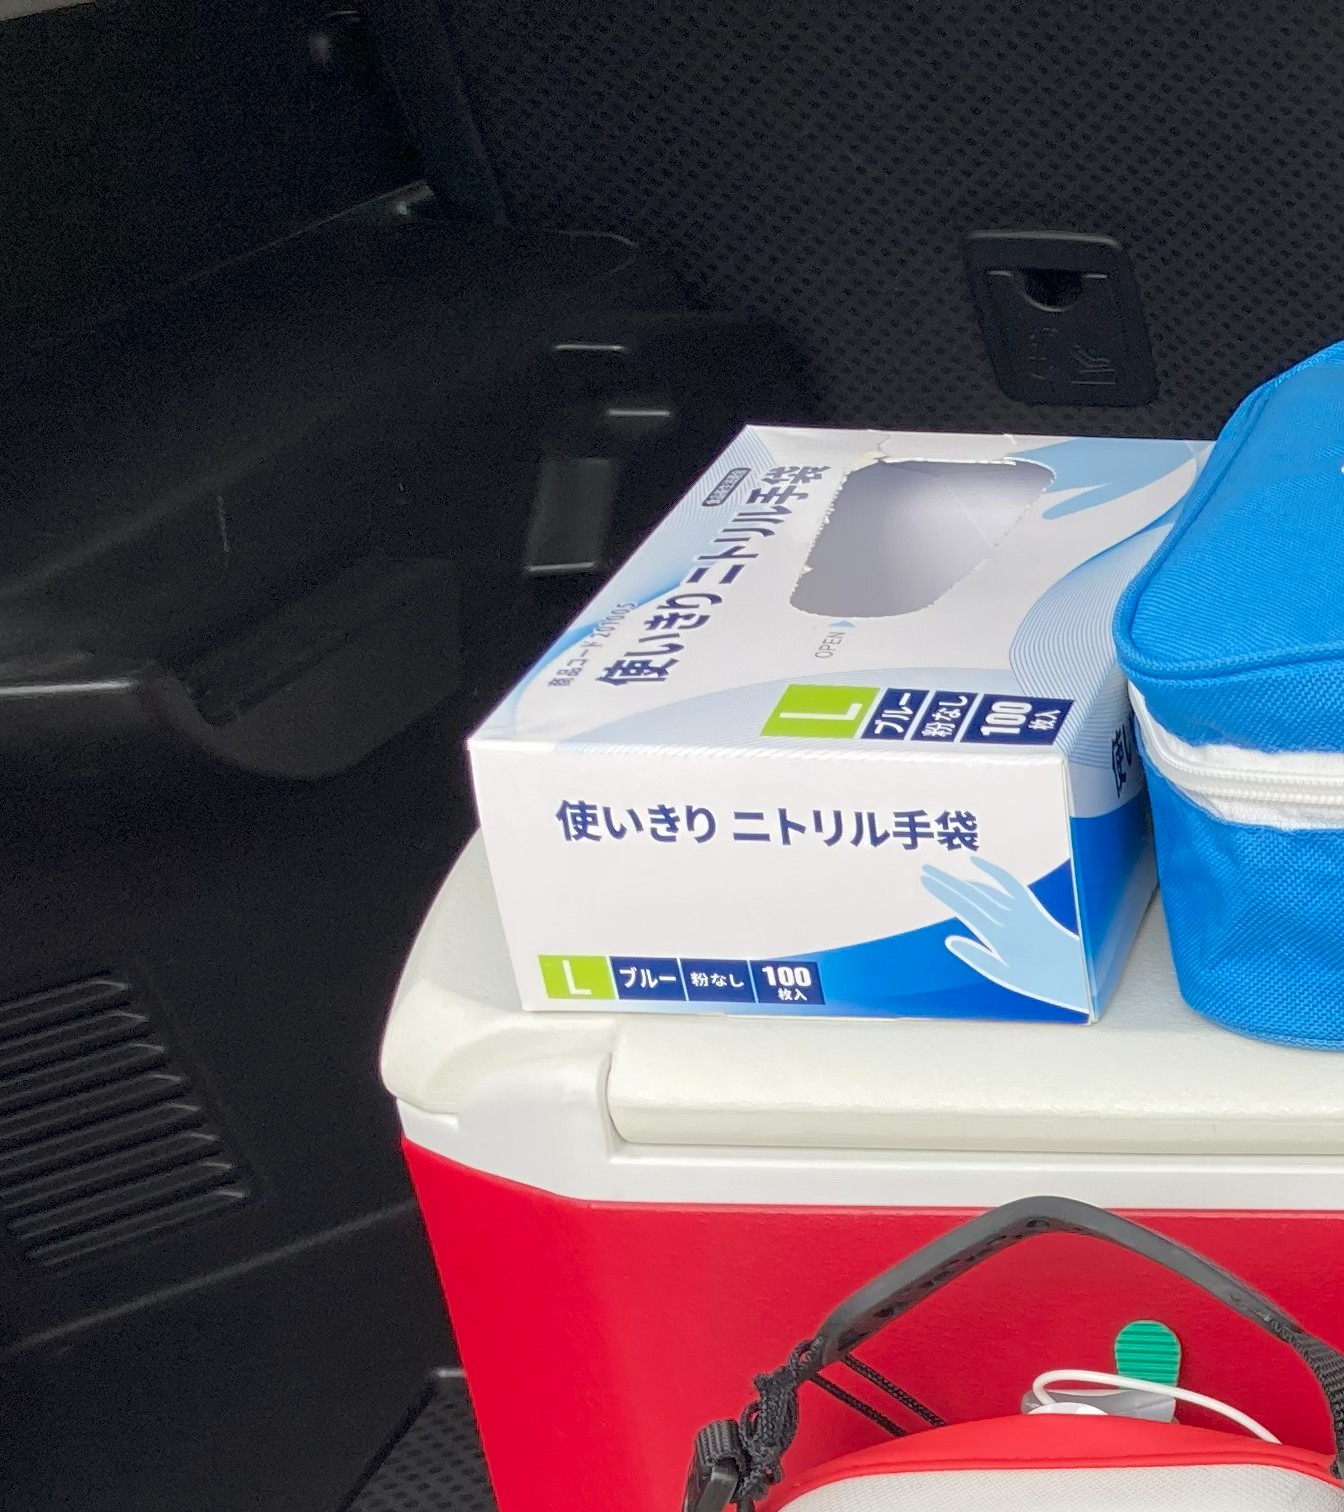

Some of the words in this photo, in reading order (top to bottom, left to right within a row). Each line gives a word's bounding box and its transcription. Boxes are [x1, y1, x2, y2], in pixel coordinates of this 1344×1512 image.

[595, 592, 723, 686] 使いきり
[685, 465, 831, 584] ニトリル手袋
[814, 631, 847, 659] OPEN
[779, 703, 863, 721] L
[874, 692, 911, 735] ブルー
[921, 695, 969, 737] 粉なし
[980, 701, 1032, 736] 100
[1028, 709, 1062, 731] 枚入
[555, 799, 717, 843] 使いきり
[732, 806, 981, 852] ニトリル手袋
[562, 960, 592, 995] L
[619, 966, 677, 989] ブルー
[690, 972, 745, 988] 粉なし
[761, 966, 812, 987] 100
[777, 987, 808, 1001] 枚入
